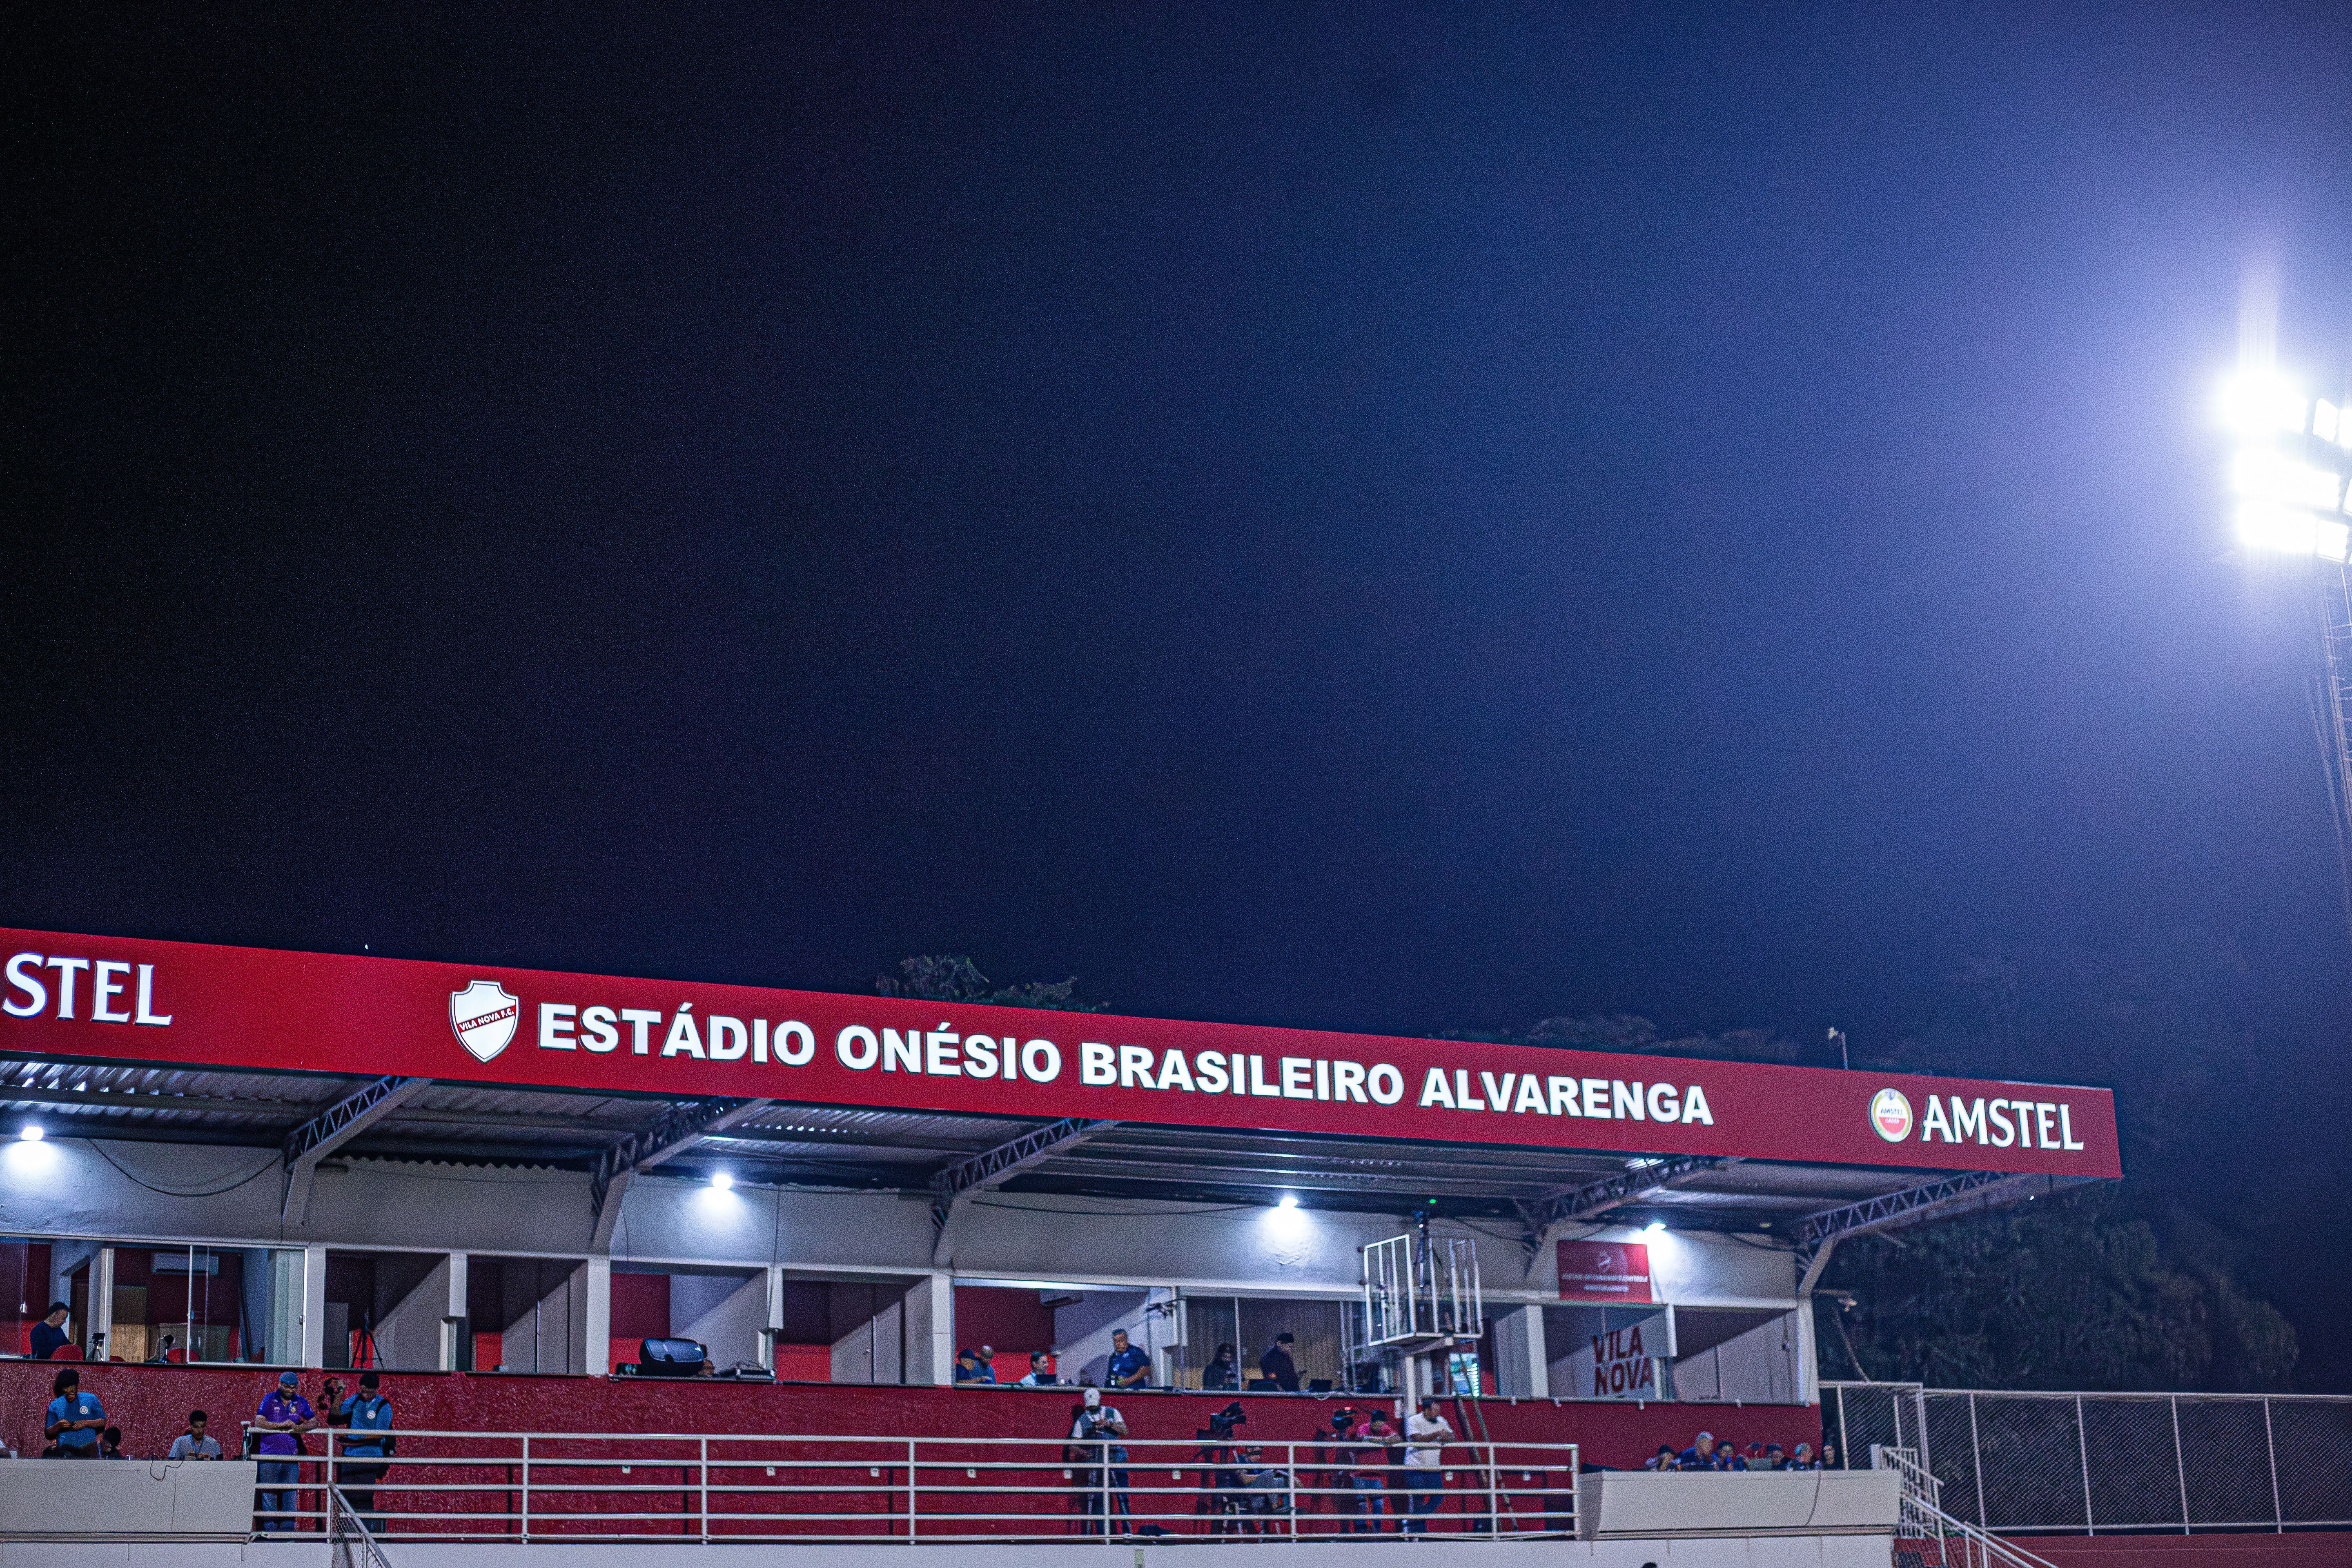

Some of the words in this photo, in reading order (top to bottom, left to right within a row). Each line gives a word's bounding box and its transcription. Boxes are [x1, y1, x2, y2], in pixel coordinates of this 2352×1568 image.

[2, 953, 172, 1026] STEL
[459, 1020, 478, 1031] VILA
[477, 1012, 501, 1025] NOVA
[500, 1007, 514, 1018] F.C.
[539, 1002, 815, 1066] ESTÁDIO
[836, 1021, 1062, 1083] ONÉSIO
[1080, 1042, 1405, 1105] BRASILEIRO
[1419, 1067, 1715, 1126] ALVARENGA
[1921, 1094, 2085, 1151] AMSTEL
[1592, 1326, 1644, 1364] VILA
[1594, 1356, 1654, 1396] NOVA
